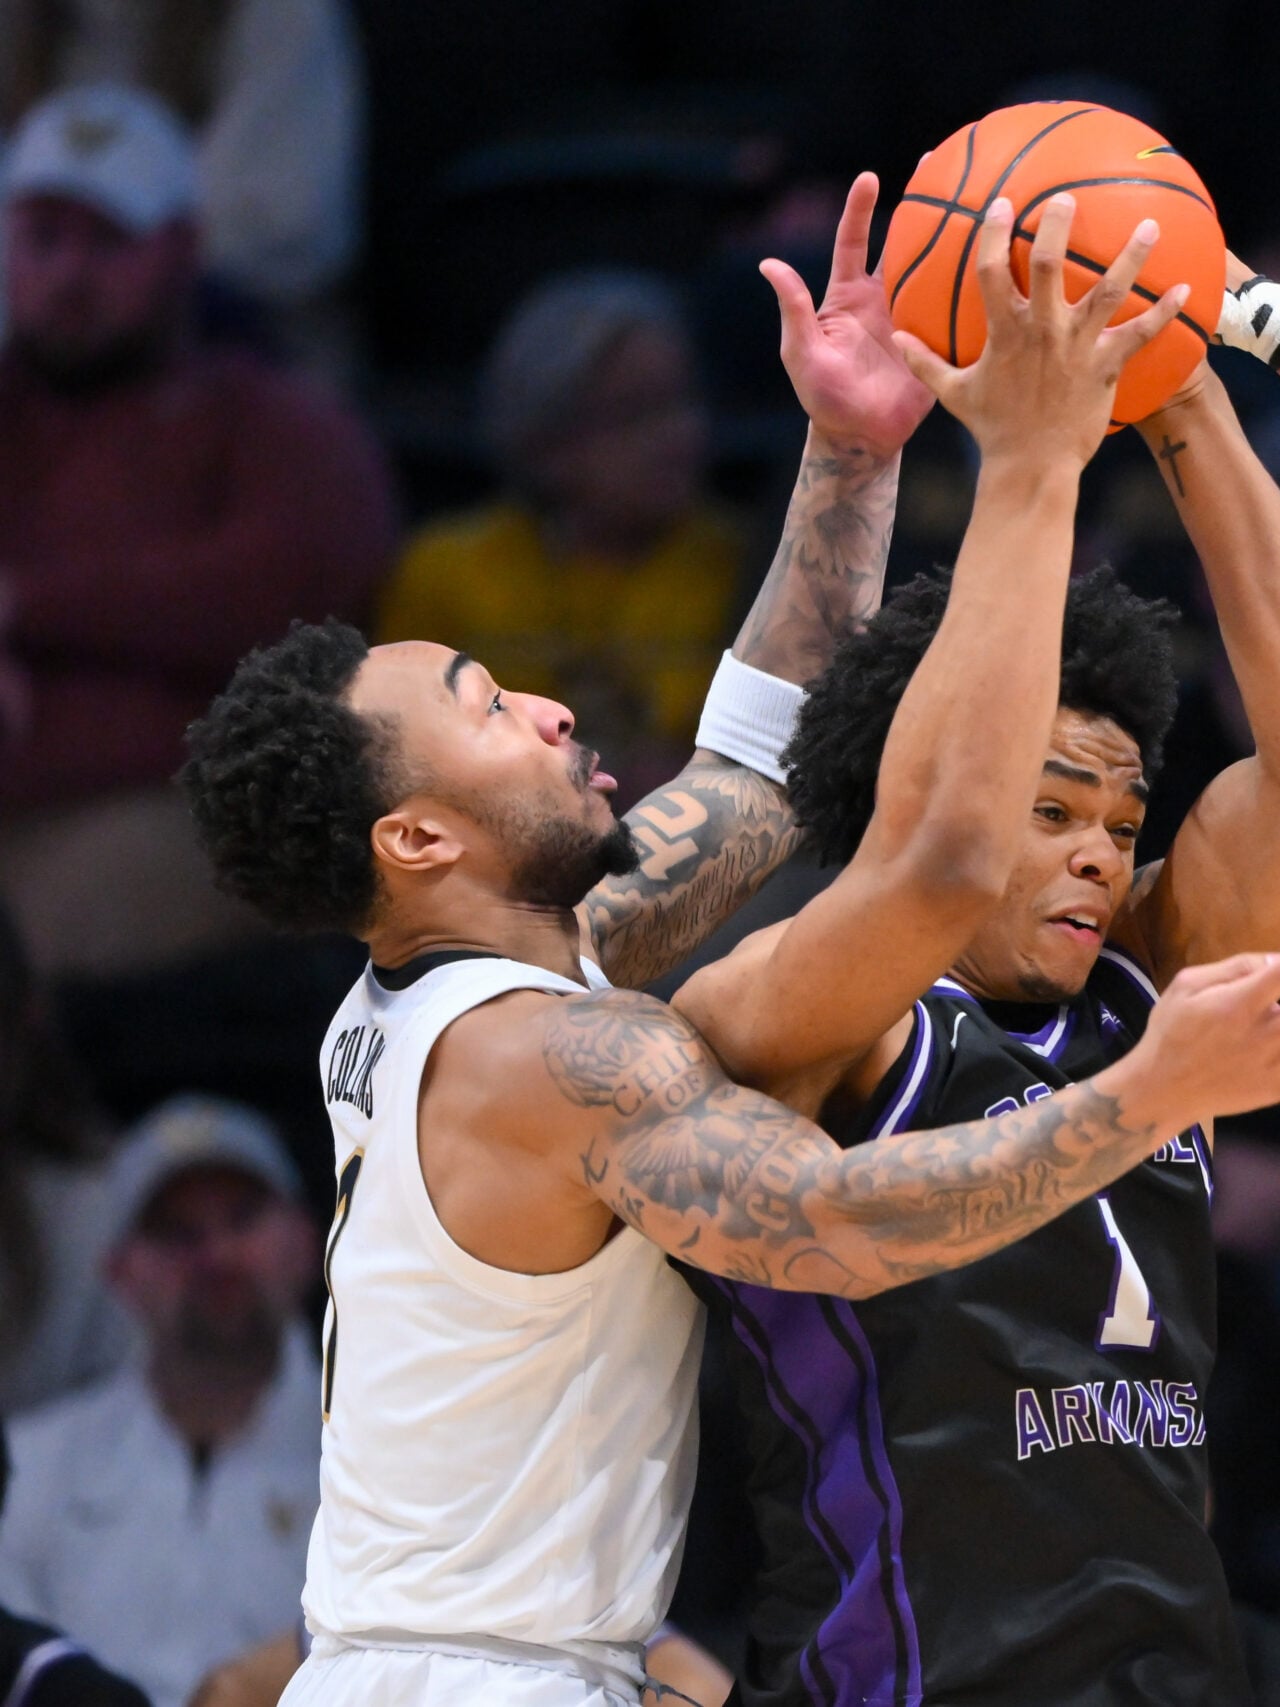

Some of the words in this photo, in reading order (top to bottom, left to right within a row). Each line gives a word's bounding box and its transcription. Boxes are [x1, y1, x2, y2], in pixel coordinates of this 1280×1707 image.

[612, 1044, 705, 1117] CHIL
[1096, 1193, 1162, 1353] 1
[1016, 1379, 1206, 1461] ARKANS
